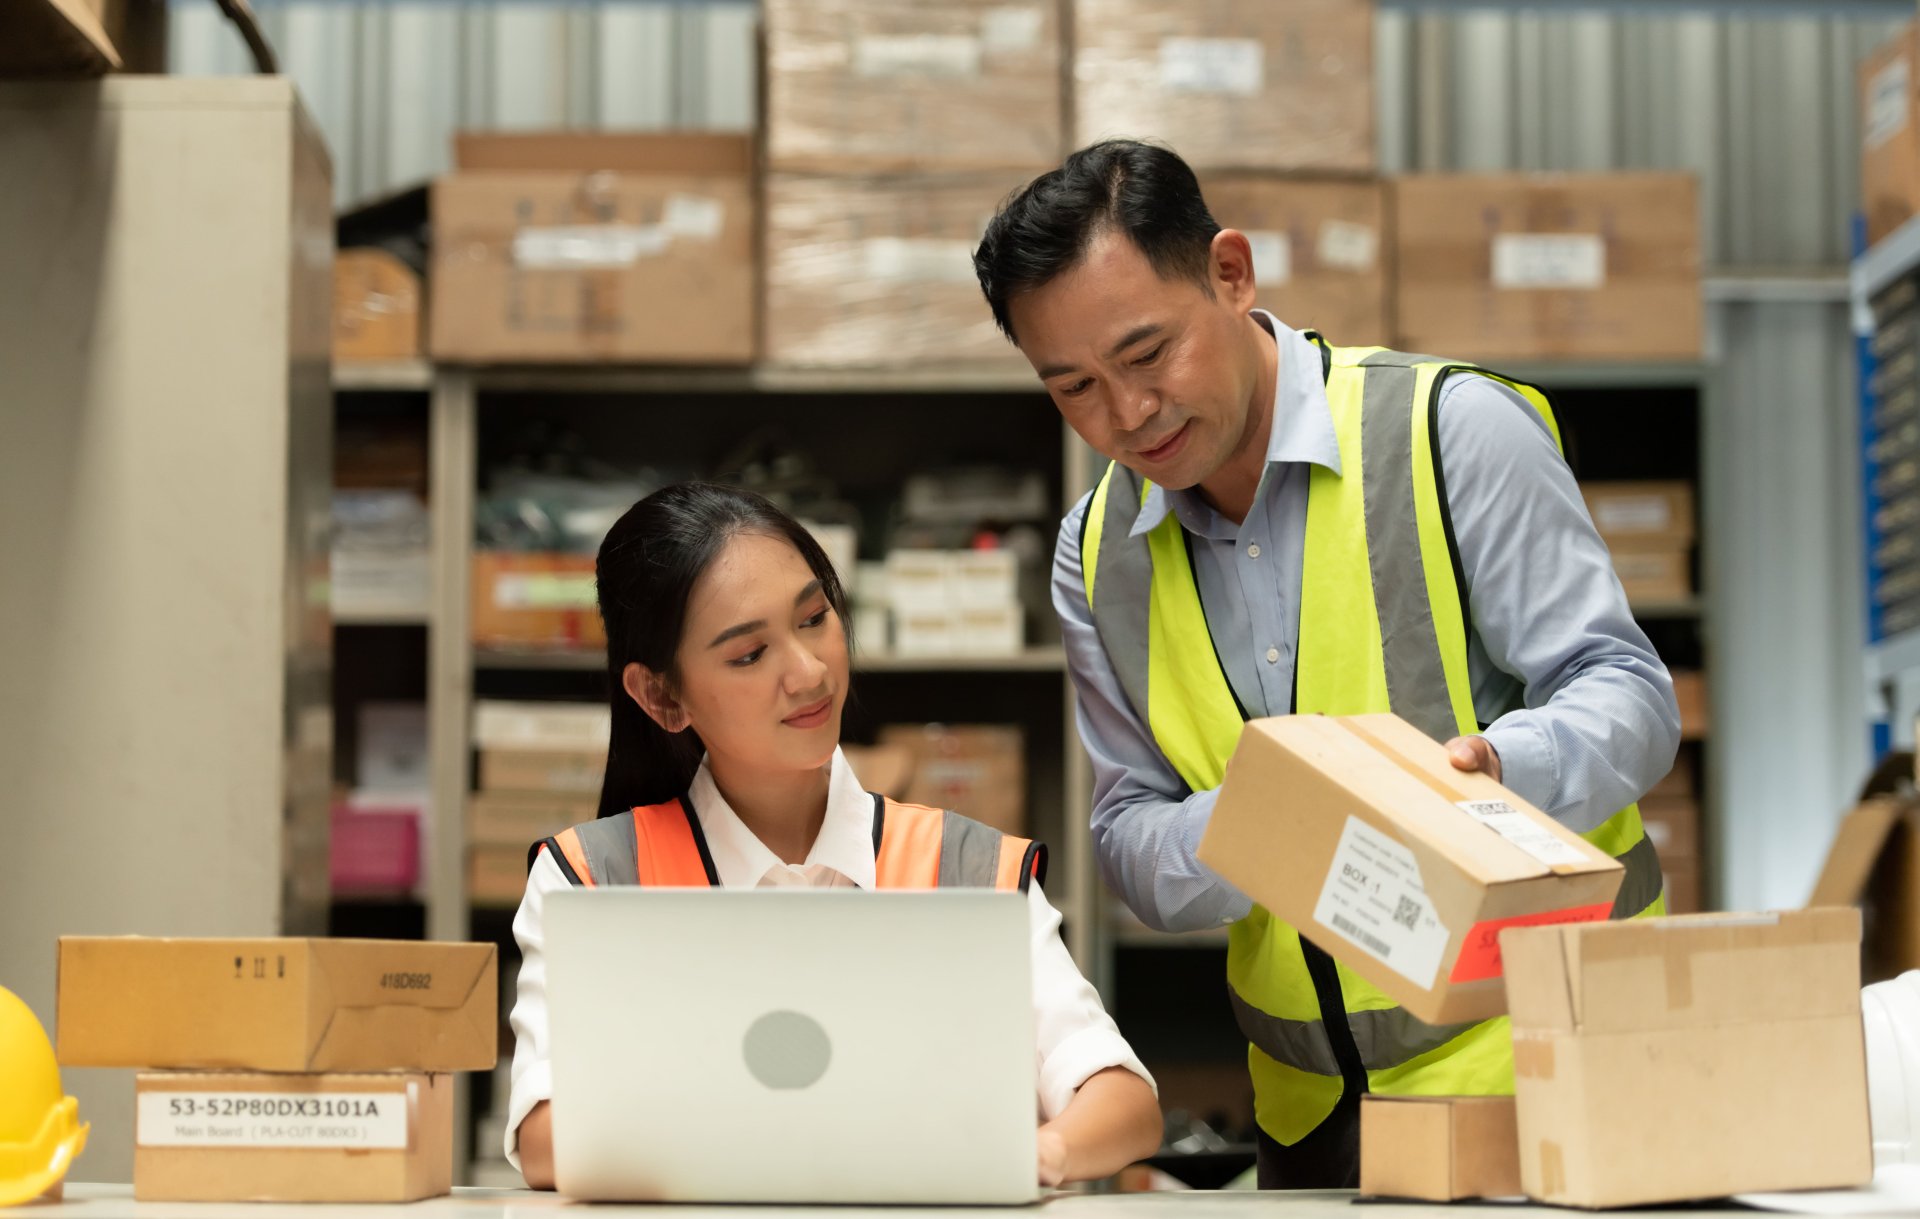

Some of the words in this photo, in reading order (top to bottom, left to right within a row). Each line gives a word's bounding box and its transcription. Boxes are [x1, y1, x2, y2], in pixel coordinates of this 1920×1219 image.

[1342, 863, 1368, 887] BOX
[379, 972, 432, 990] 418D692
[169, 1098, 380, 1117] 53-52P80DX3101A
[175, 1125, 203, 1138] Main
[208, 1125, 243, 1138] Board
